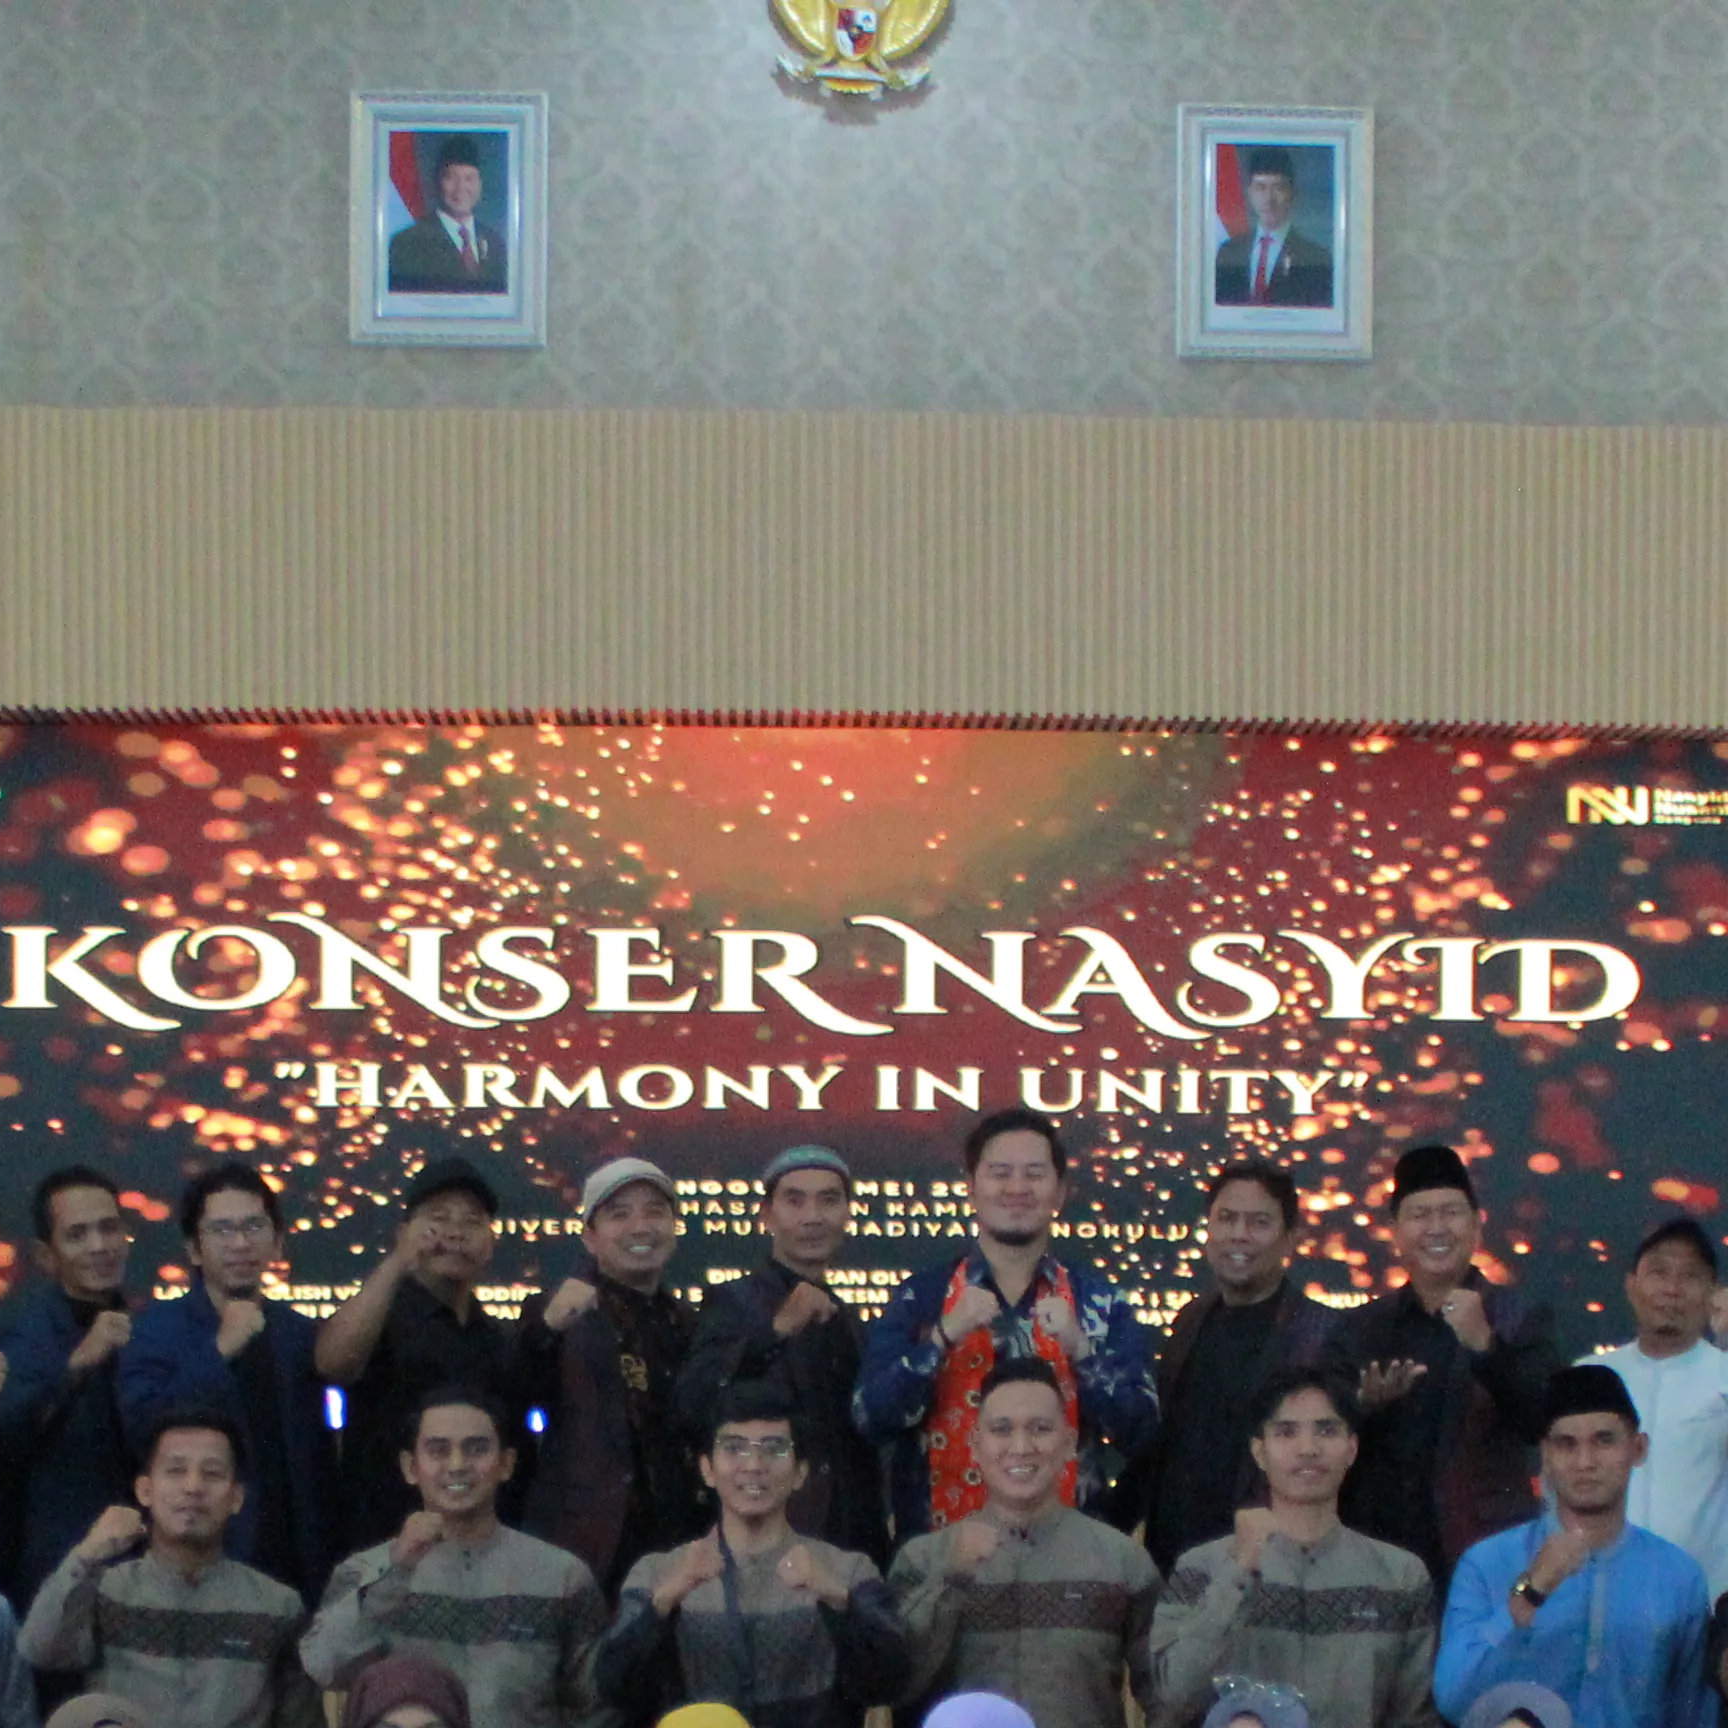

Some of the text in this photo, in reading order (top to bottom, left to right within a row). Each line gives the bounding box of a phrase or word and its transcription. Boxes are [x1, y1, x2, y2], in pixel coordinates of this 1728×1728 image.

[1, 911, 1642, 1041] KONSER NASYID
[875, 1064, 985, 1112] IN
[853, 1180, 915, 1197] MEI
[1049, 1221, 1190, 1241] NGKULU
